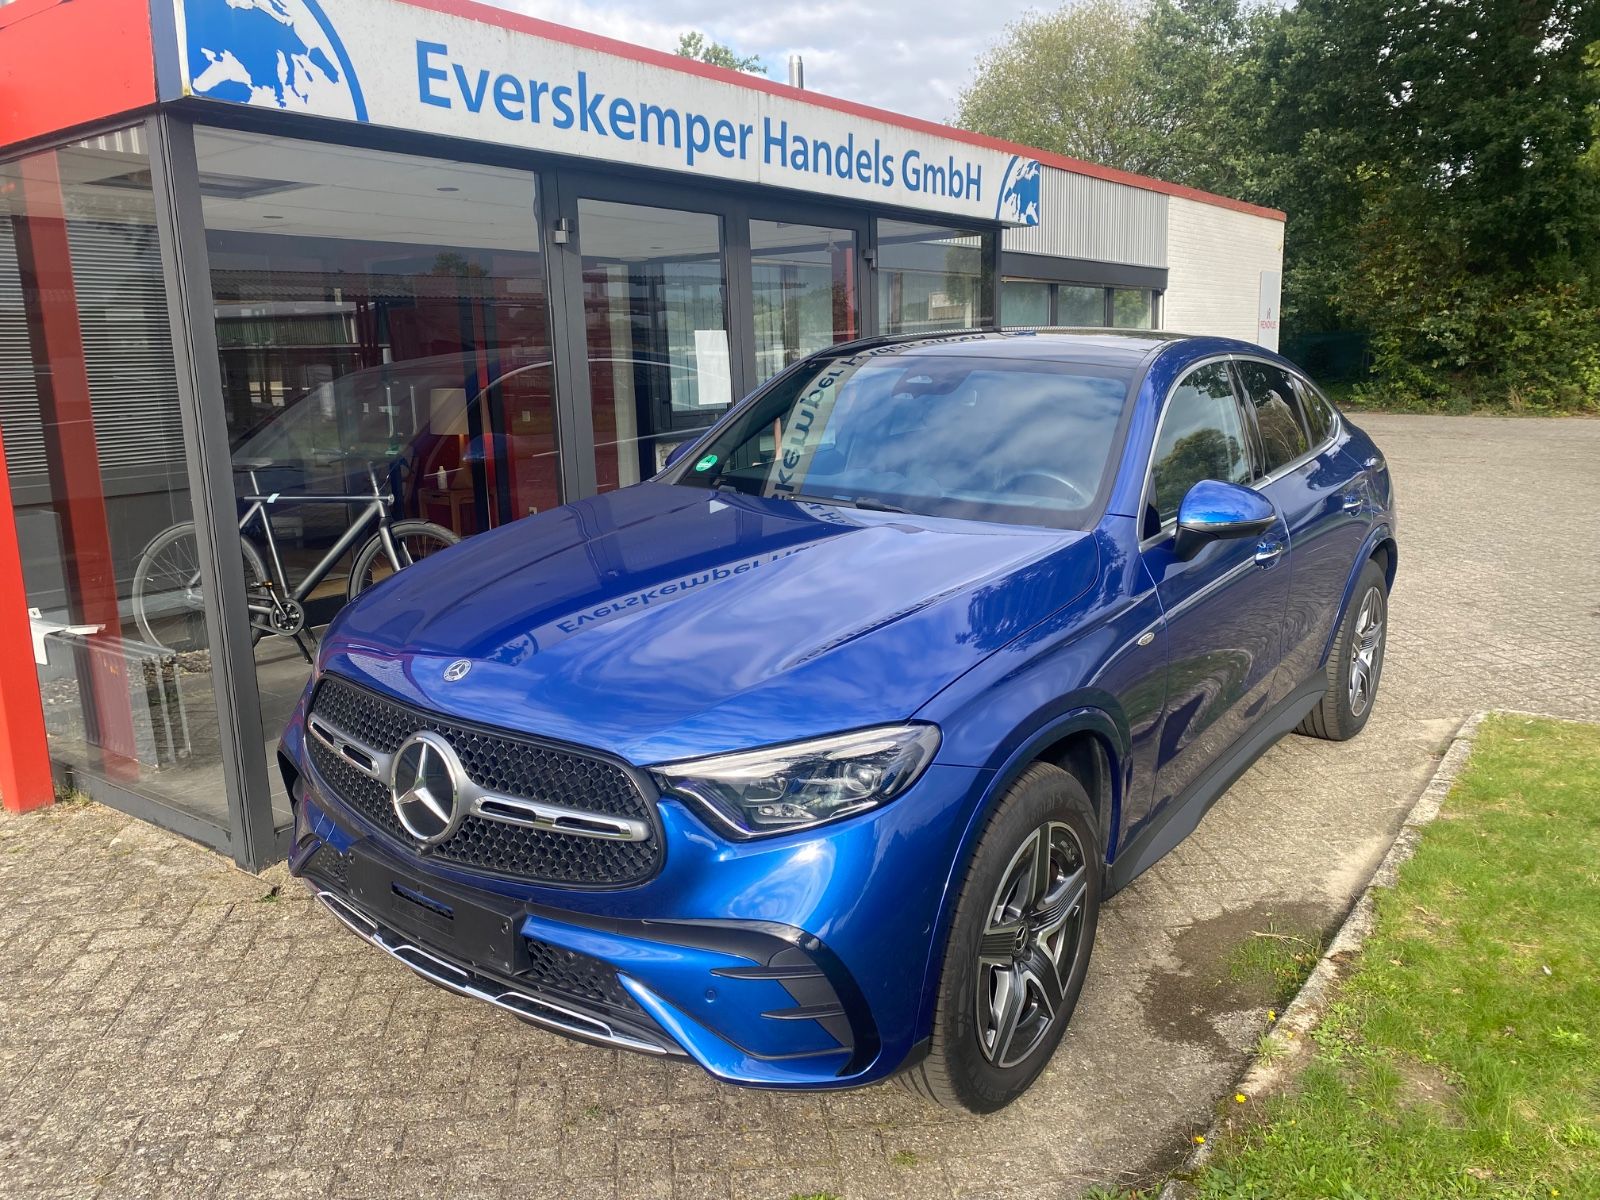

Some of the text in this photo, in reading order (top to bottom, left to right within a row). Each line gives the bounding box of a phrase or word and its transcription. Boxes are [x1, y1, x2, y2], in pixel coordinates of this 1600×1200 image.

[416, 40, 982, 202] Everskemper Handels GmbH
